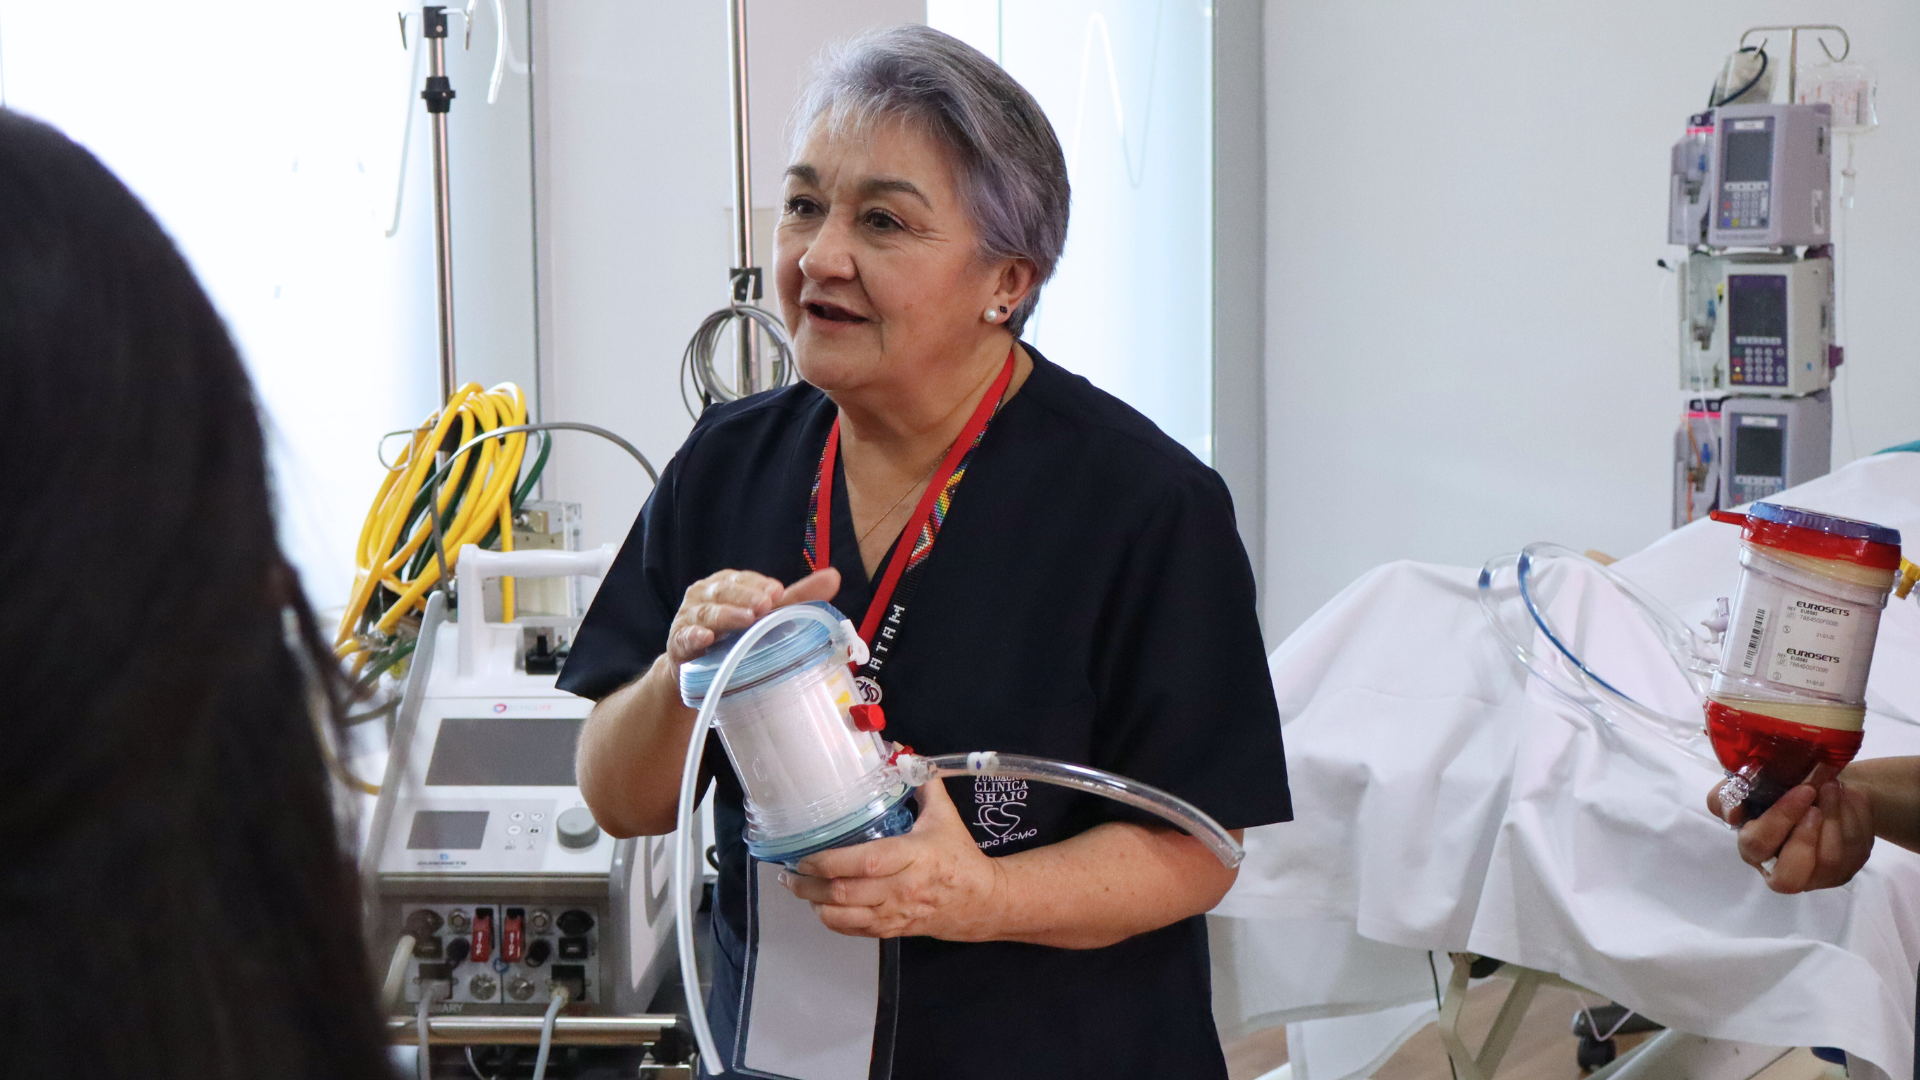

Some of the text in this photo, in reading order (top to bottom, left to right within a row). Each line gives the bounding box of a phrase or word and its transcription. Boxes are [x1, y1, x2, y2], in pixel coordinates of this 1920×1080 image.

[1796, 601, 1850, 617] EUROSETS
[869, 604, 905, 680] ATAM
[1786, 648, 1840, 664] EUROSETS
[974, 781, 1028, 792] CLINICA
[974, 790, 1028, 804] SHAIO
[1003, 828, 1037, 844] ECMO
